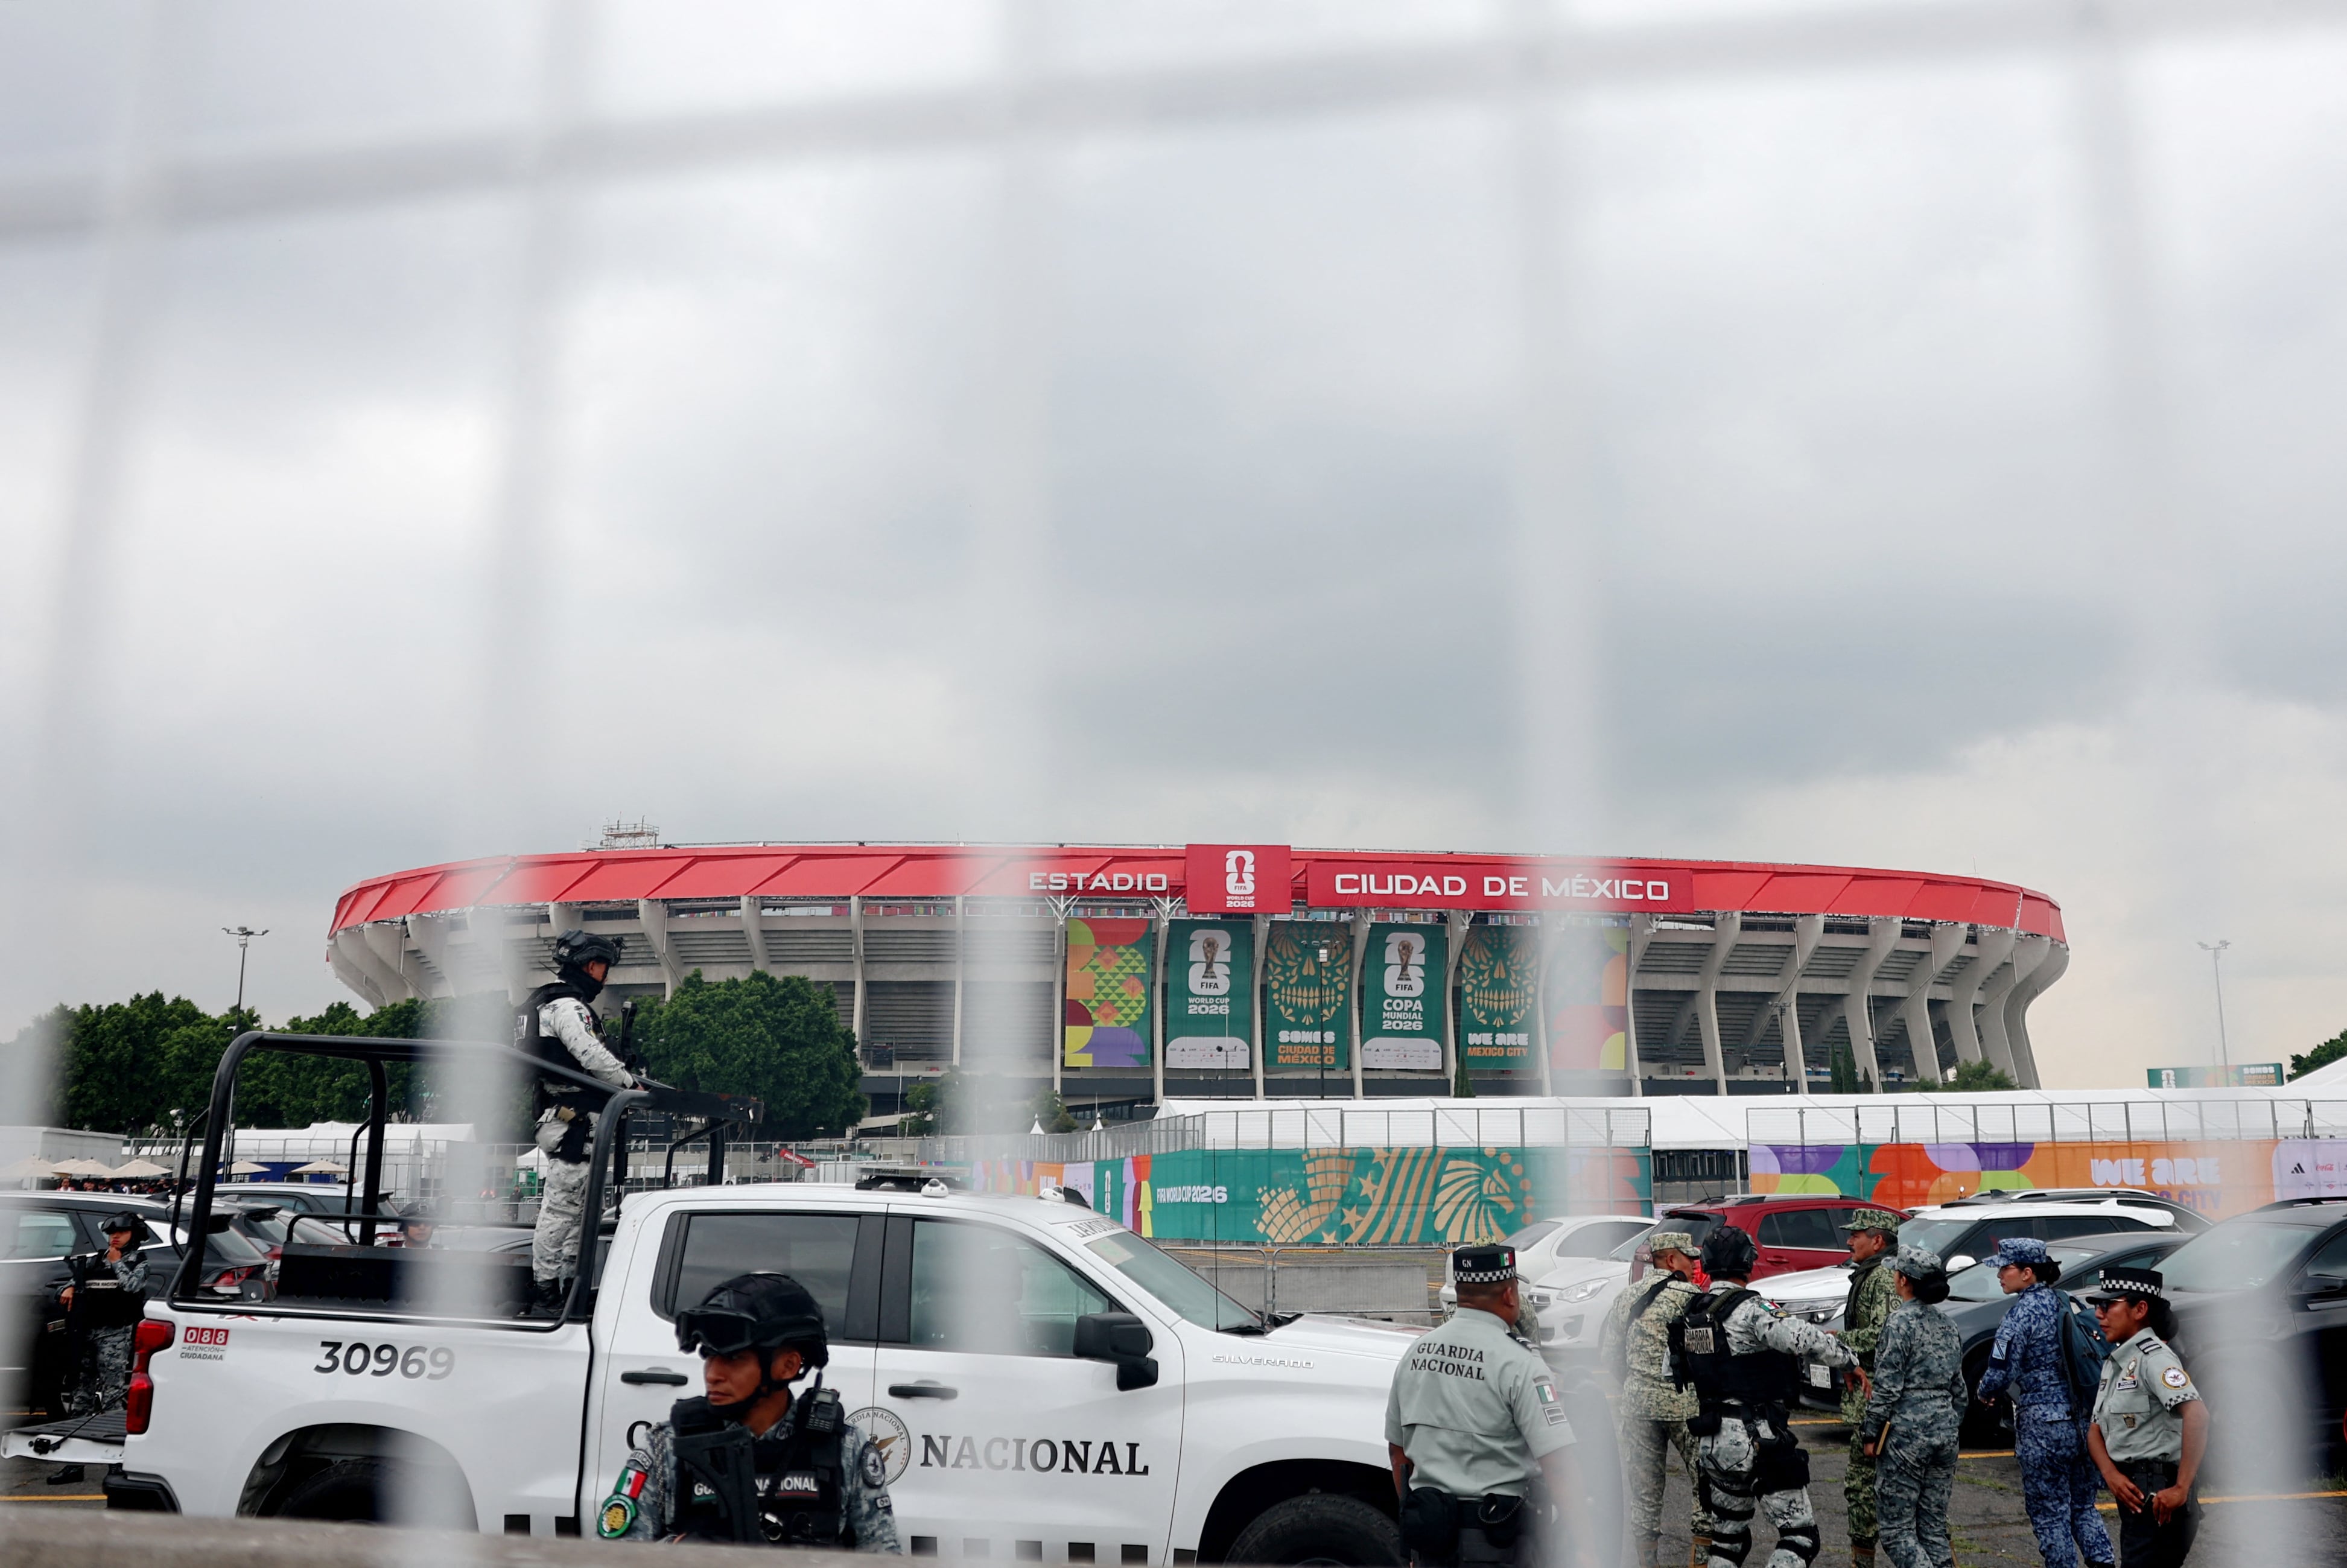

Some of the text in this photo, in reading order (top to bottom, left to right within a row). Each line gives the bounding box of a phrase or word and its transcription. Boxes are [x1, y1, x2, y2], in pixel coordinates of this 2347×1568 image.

[1029, 872, 1167, 891] ESTADIO
[1335, 874, 1669, 900] CIUDAD DE MÉXICO
[1188, 1005, 1230, 1015] 2026
[1383, 999, 1423, 1012] COPA
[1382, 1021, 1423, 1030] 2026
[1278, 1030, 1335, 1043] SOMOS
[1468, 1033, 1528, 1046] WE ARE
[1278, 1046, 1320, 1054] CIUDAD
[1467, 1047, 1528, 1056] MEXICO CITY
[1277, 1053, 1335, 1064] MÉXICO
[2091, 1158, 2221, 1186] WE ARE
[1157, 1185, 1228, 1204] FIFA WORLD CUP 2026
[1462, 1259, 1472, 1268] GN
[186, 1328, 226, 1344] 088
[180, 1352, 224, 1360] CIUDADANA
[314, 1341, 456, 1380] 30969
[1417, 1343, 1484, 1363] GUARDIA
[1212, 1354, 1314, 1370] SILVERADO
[1411, 1359, 1485, 1381] NACIONAL
[851, 1412, 905, 1443] RDIA NACIONAL
[920, 1435, 1149, 1476] NACIONAL
[755, 1476, 818, 1491] NAIONAL
